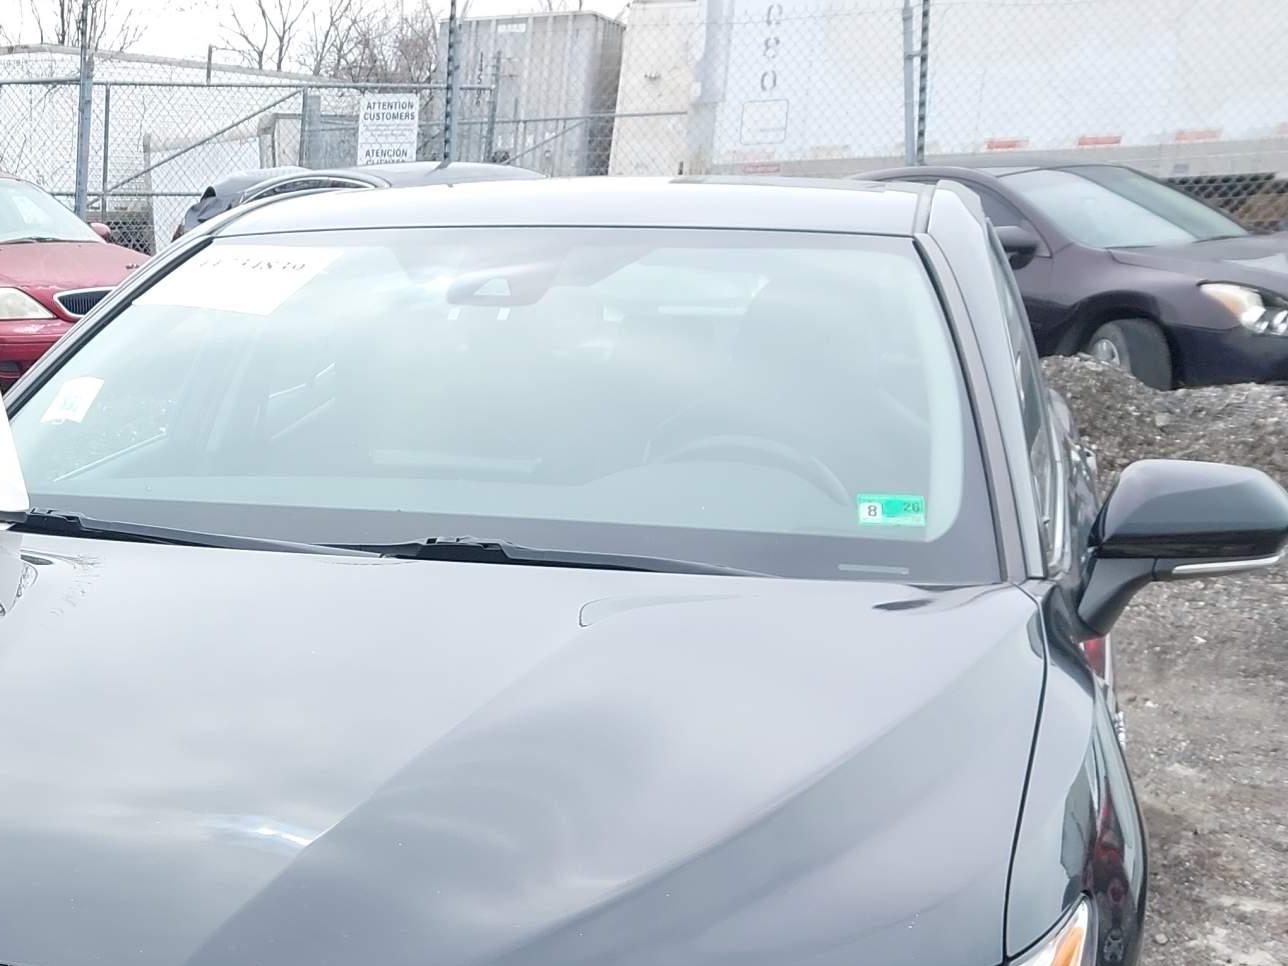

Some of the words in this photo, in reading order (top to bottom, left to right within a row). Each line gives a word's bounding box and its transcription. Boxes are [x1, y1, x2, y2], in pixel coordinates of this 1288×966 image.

[366, 101, 414, 110] ATTENTION
[363, 111, 415, 121] CUSTOMERS
[867, 505, 878, 517] 8
[903, 502, 920, 513] 26
